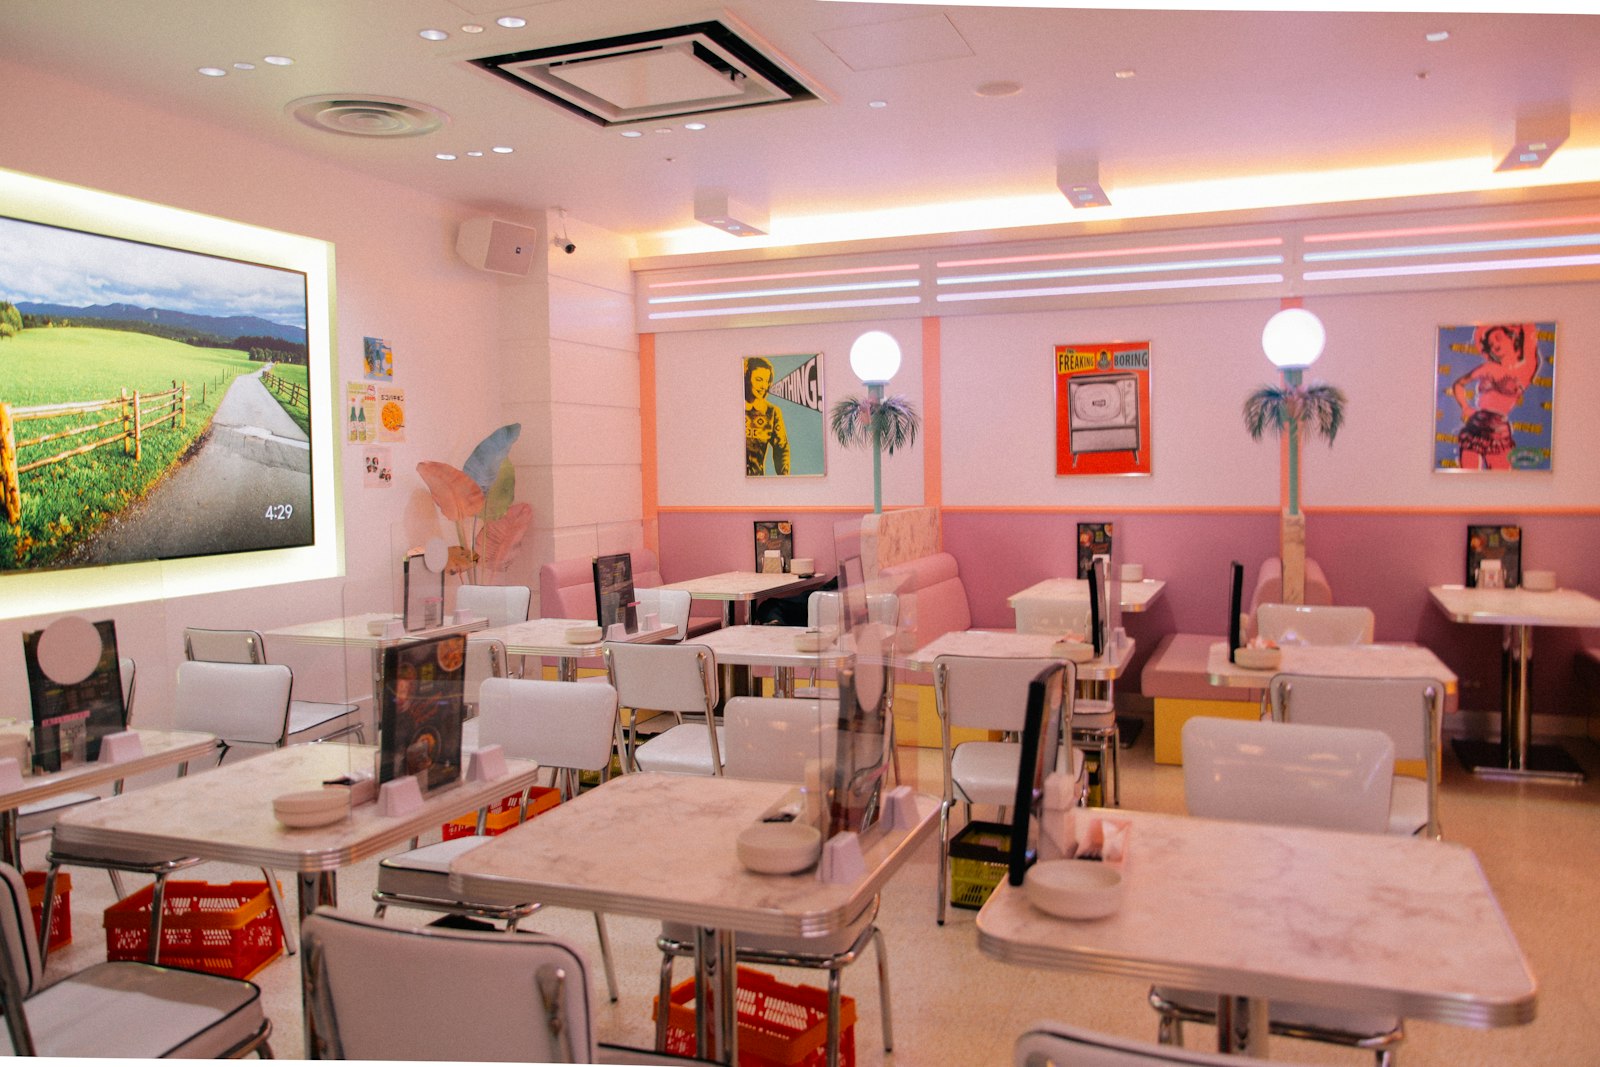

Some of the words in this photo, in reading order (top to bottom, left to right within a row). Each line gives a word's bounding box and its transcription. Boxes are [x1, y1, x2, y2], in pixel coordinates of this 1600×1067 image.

[1059, 353, 1094, 372] FREAKING
[1114, 351, 1148, 368] BORING
[769, 353, 823, 412] YTHING!
[265, 504, 293, 520] 4:29
